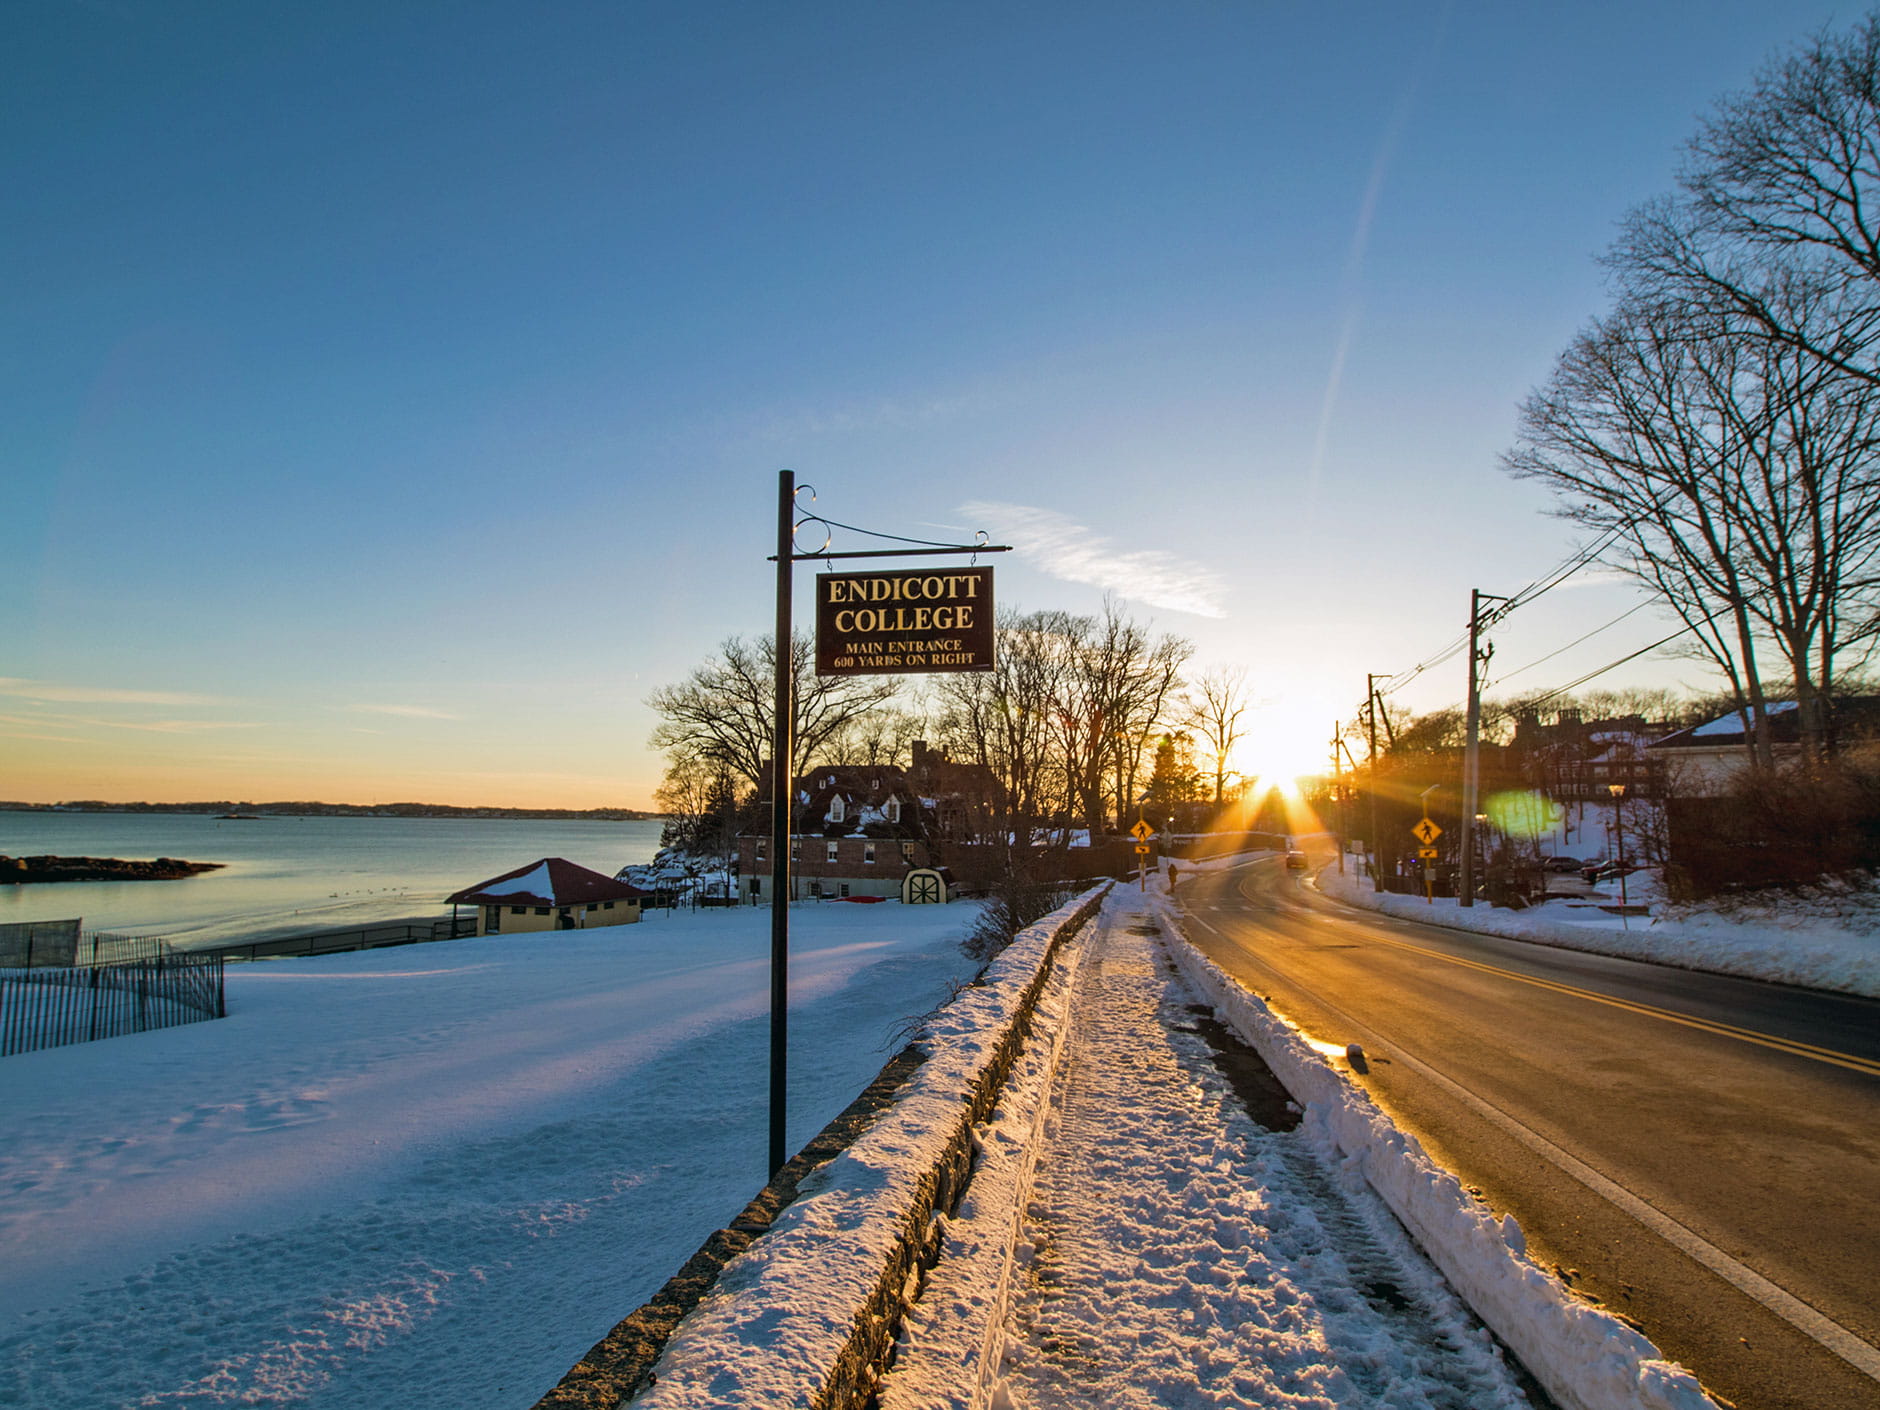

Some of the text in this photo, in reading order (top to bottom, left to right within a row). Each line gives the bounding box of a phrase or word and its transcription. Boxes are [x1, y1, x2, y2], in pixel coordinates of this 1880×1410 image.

[828, 575, 981, 603] ENDICOTT
[835, 606, 974, 633] COLLEGE
[846, 639, 962, 654] MAIN ENTRANCE
[834, 652, 975, 668] 600 YARDS ON RIGHT
